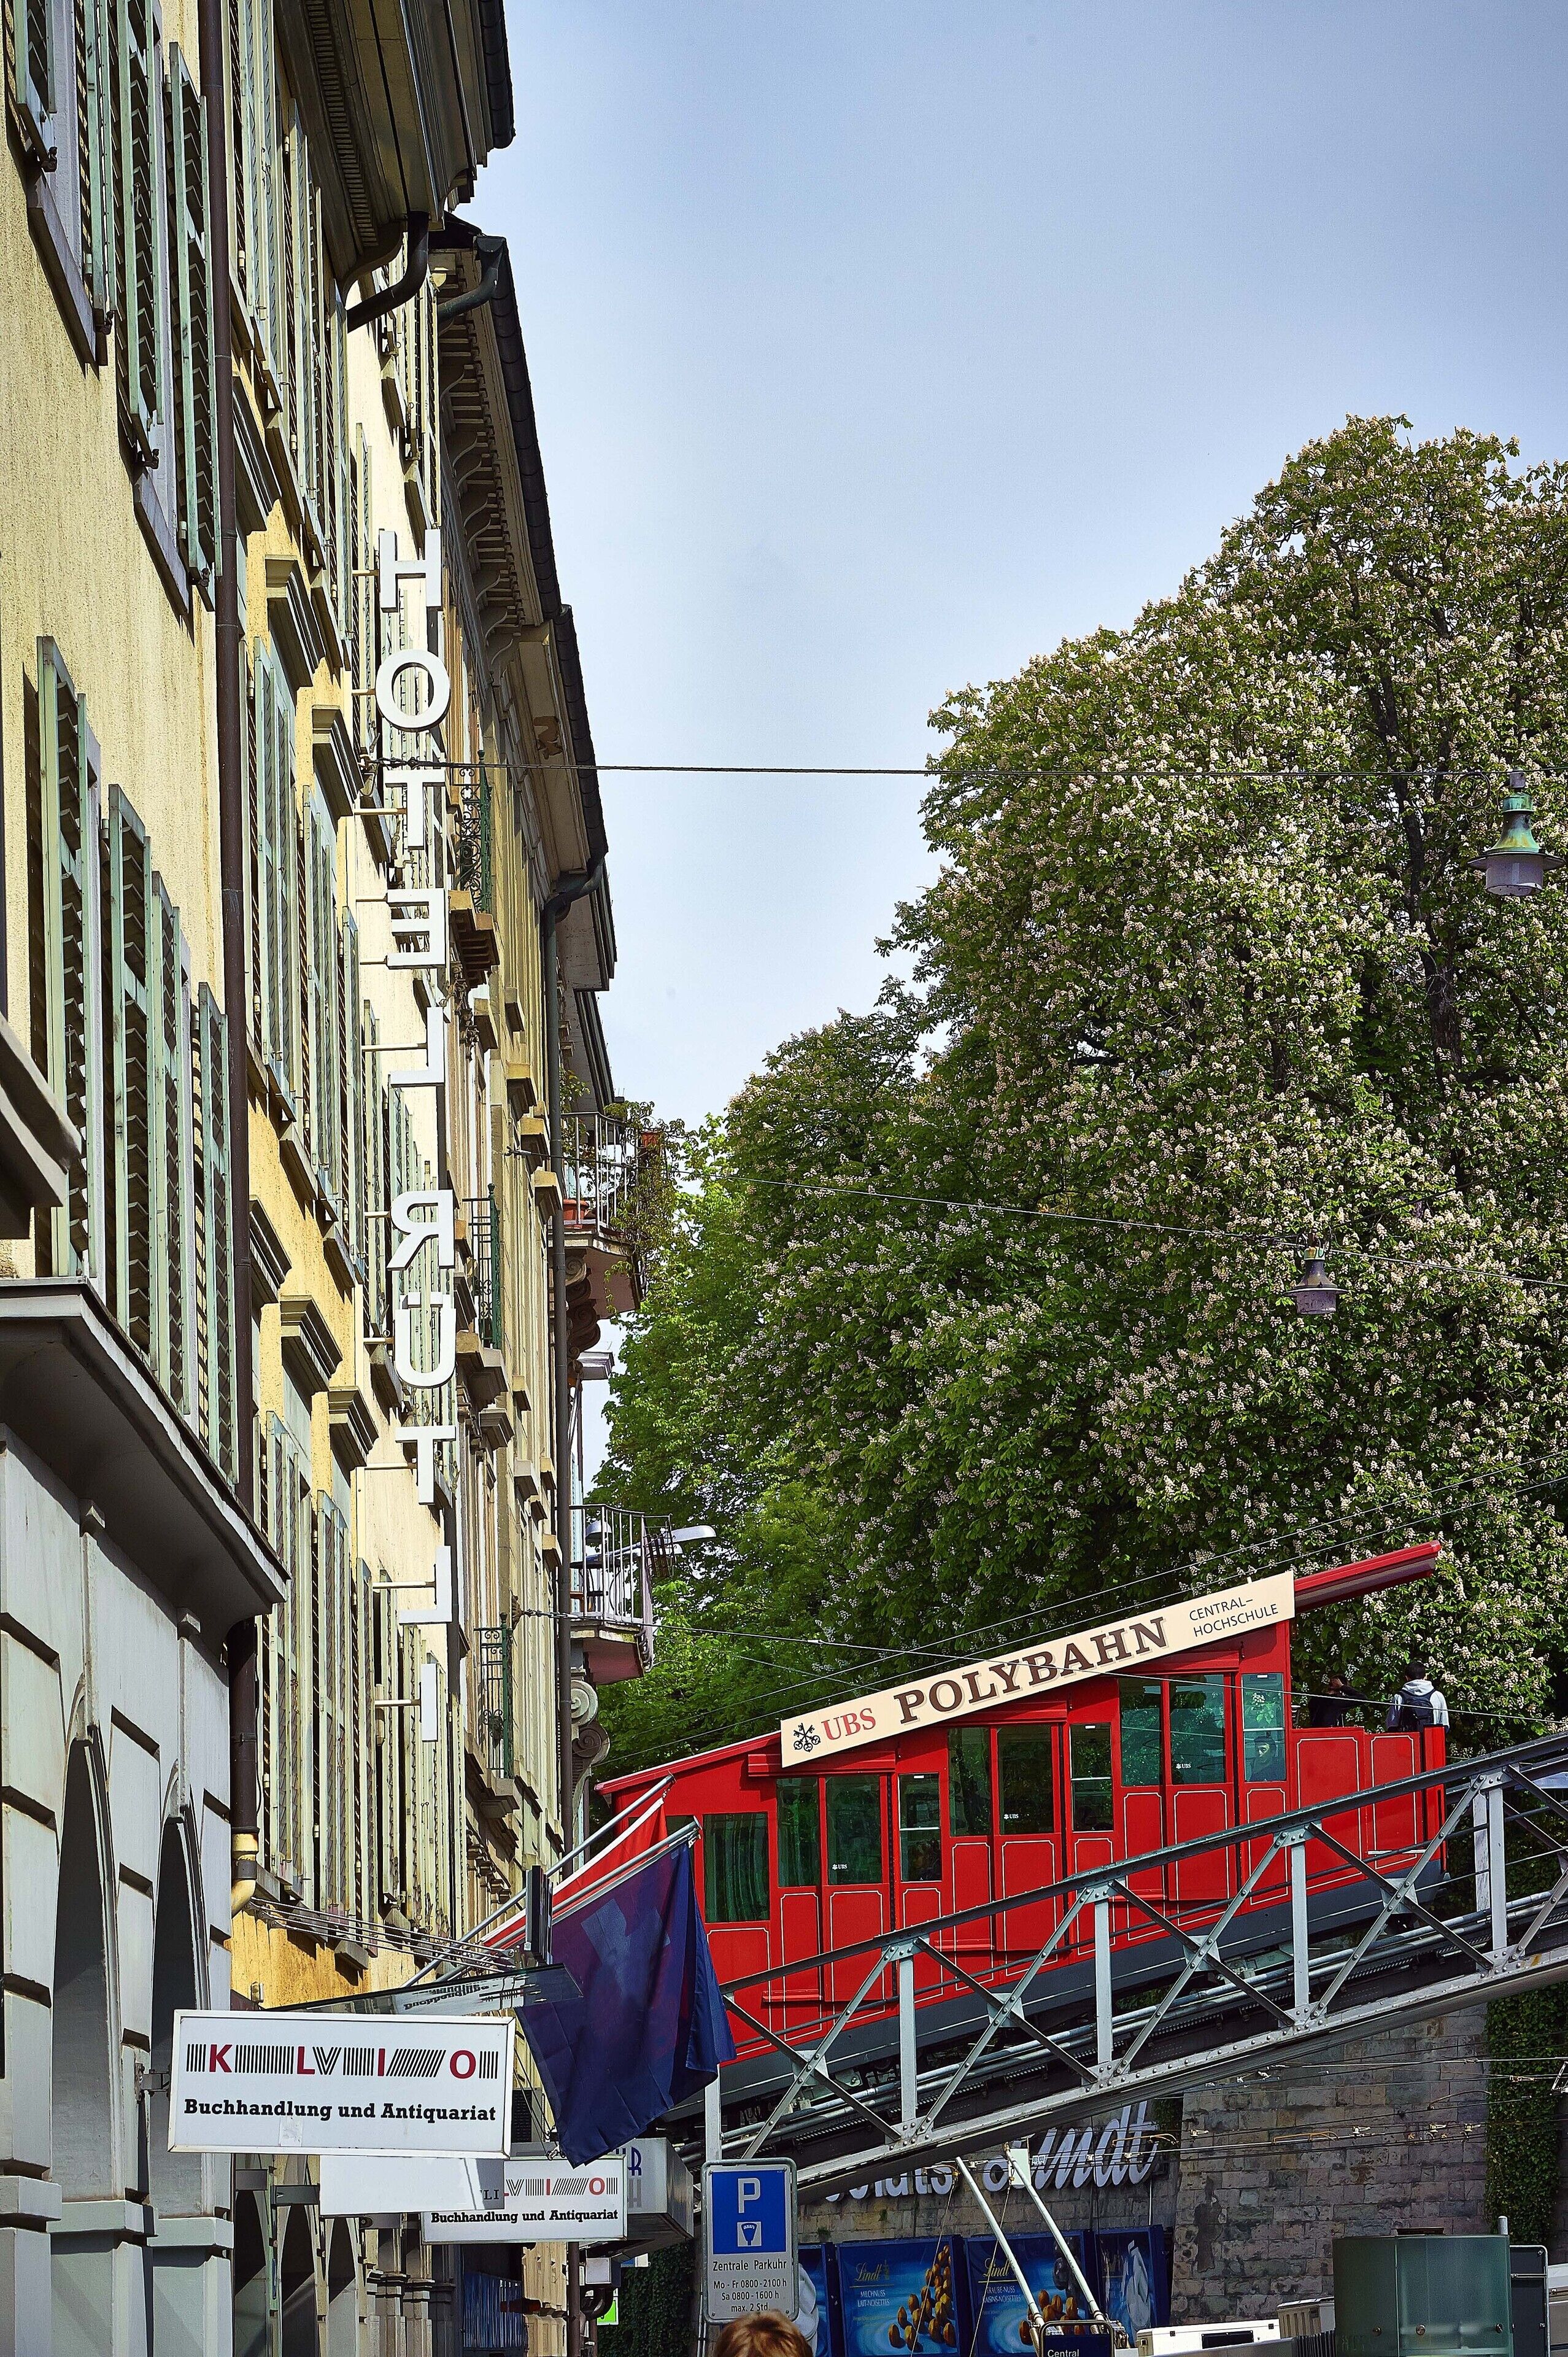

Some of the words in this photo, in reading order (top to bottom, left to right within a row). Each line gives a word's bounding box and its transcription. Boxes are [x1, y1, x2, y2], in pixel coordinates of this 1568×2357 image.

[1193, 1603, 1278, 1637] HOCHSCHULE
[821, 1708, 876, 1740] UBS
[894, 1617, 1168, 1725] POLYBAHN
[184, 2099, 332, 2120] Buchhandlung
[338, 2103, 376, 2118] und
[380, 2103, 496, 2123] Antiquariat
[738, 2178, 760, 2213] P
[431, 2211, 518, 2224] Buchhandlung
[522, 2210, 545, 2221] und
[551, 2210, 619, 2223] Antiquariat
[713, 2259, 748, 2271] Zentrale
[754, 2258, 786, 2270] Parkuhr
[855, 2262, 882, 2282] Lindt
[774, 2290, 779, 2299] h
